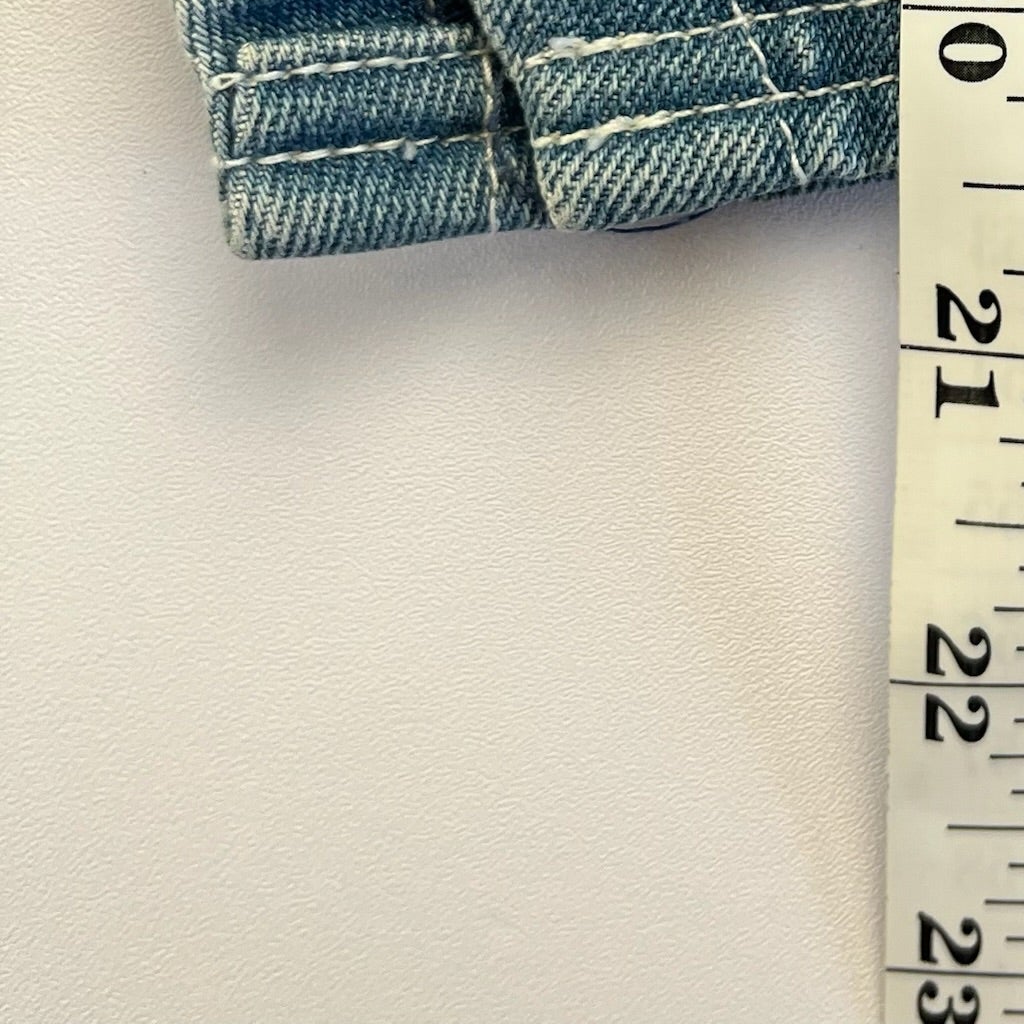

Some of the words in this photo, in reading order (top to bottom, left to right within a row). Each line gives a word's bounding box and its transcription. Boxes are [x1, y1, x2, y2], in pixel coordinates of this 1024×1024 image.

[934, 283, 1002, 419] 21
[924, 623, 992, 743] 22
[917, 910, 982, 1024] 23
